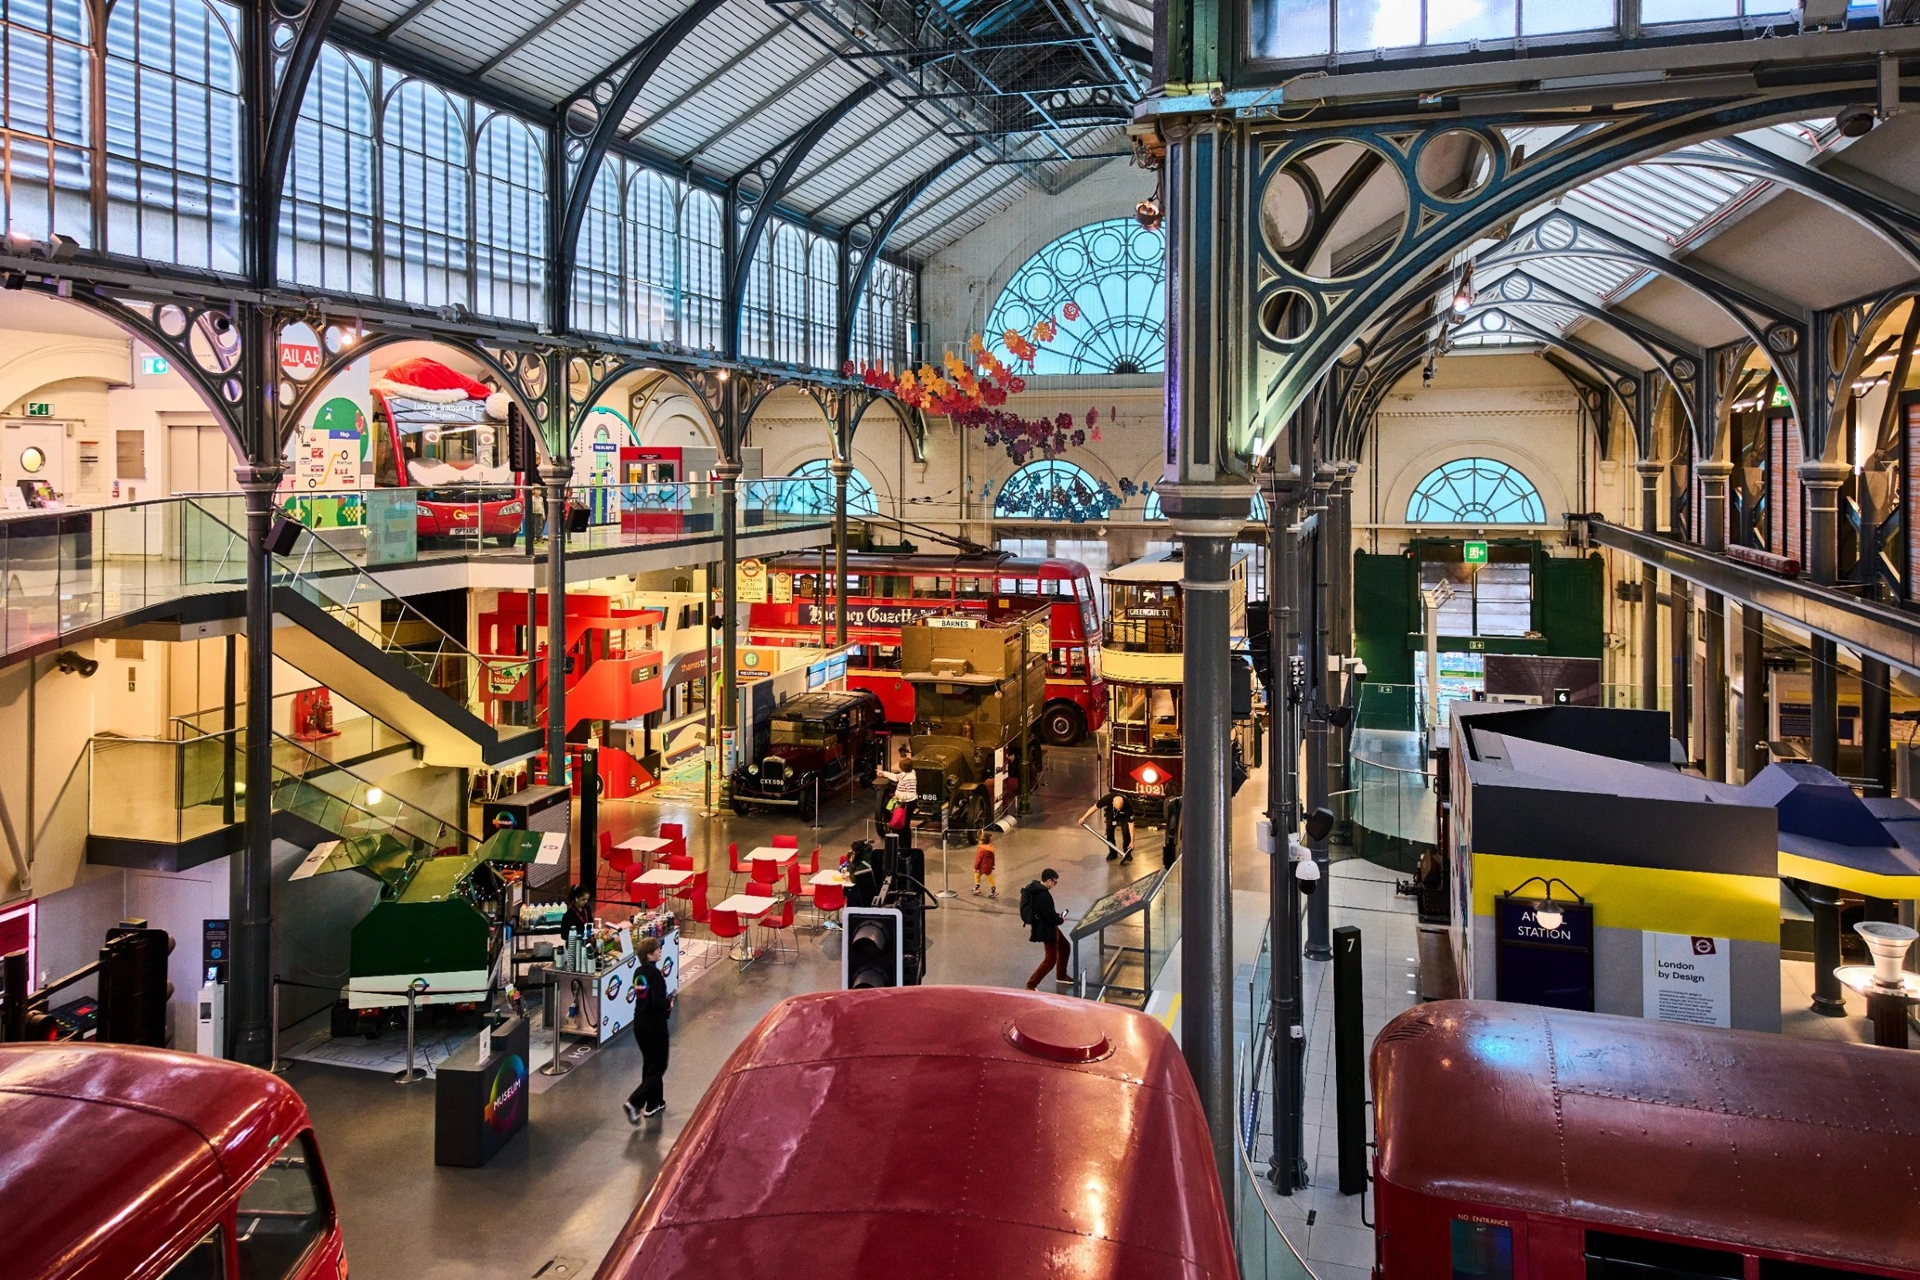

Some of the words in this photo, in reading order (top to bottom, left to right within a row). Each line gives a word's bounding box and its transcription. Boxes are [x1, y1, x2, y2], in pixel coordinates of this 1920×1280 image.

[282, 347, 300, 363] All
[413, 402, 437, 411] London
[439, 403, 471, 413] Transport
[430, 411, 456, 419] Museum
[867, 606, 918, 624] Gazette
[942, 620, 969, 628] BARNES
[1559, 692, 1567, 702] 6
[583, 753, 592, 761] 10
[1518, 926, 1571, 940] STATION
[1347, 937, 1355, 953] 7
[1658, 960, 1694, 970] London
[1658, 971, 1670, 979] by
[1672, 972, 1705, 983] Design
[493, 1078, 521, 1111] MUSEUM
[1458, 1213, 1469, 1221] NO
[1472, 1216, 1510, 1227] ENTRANCE
